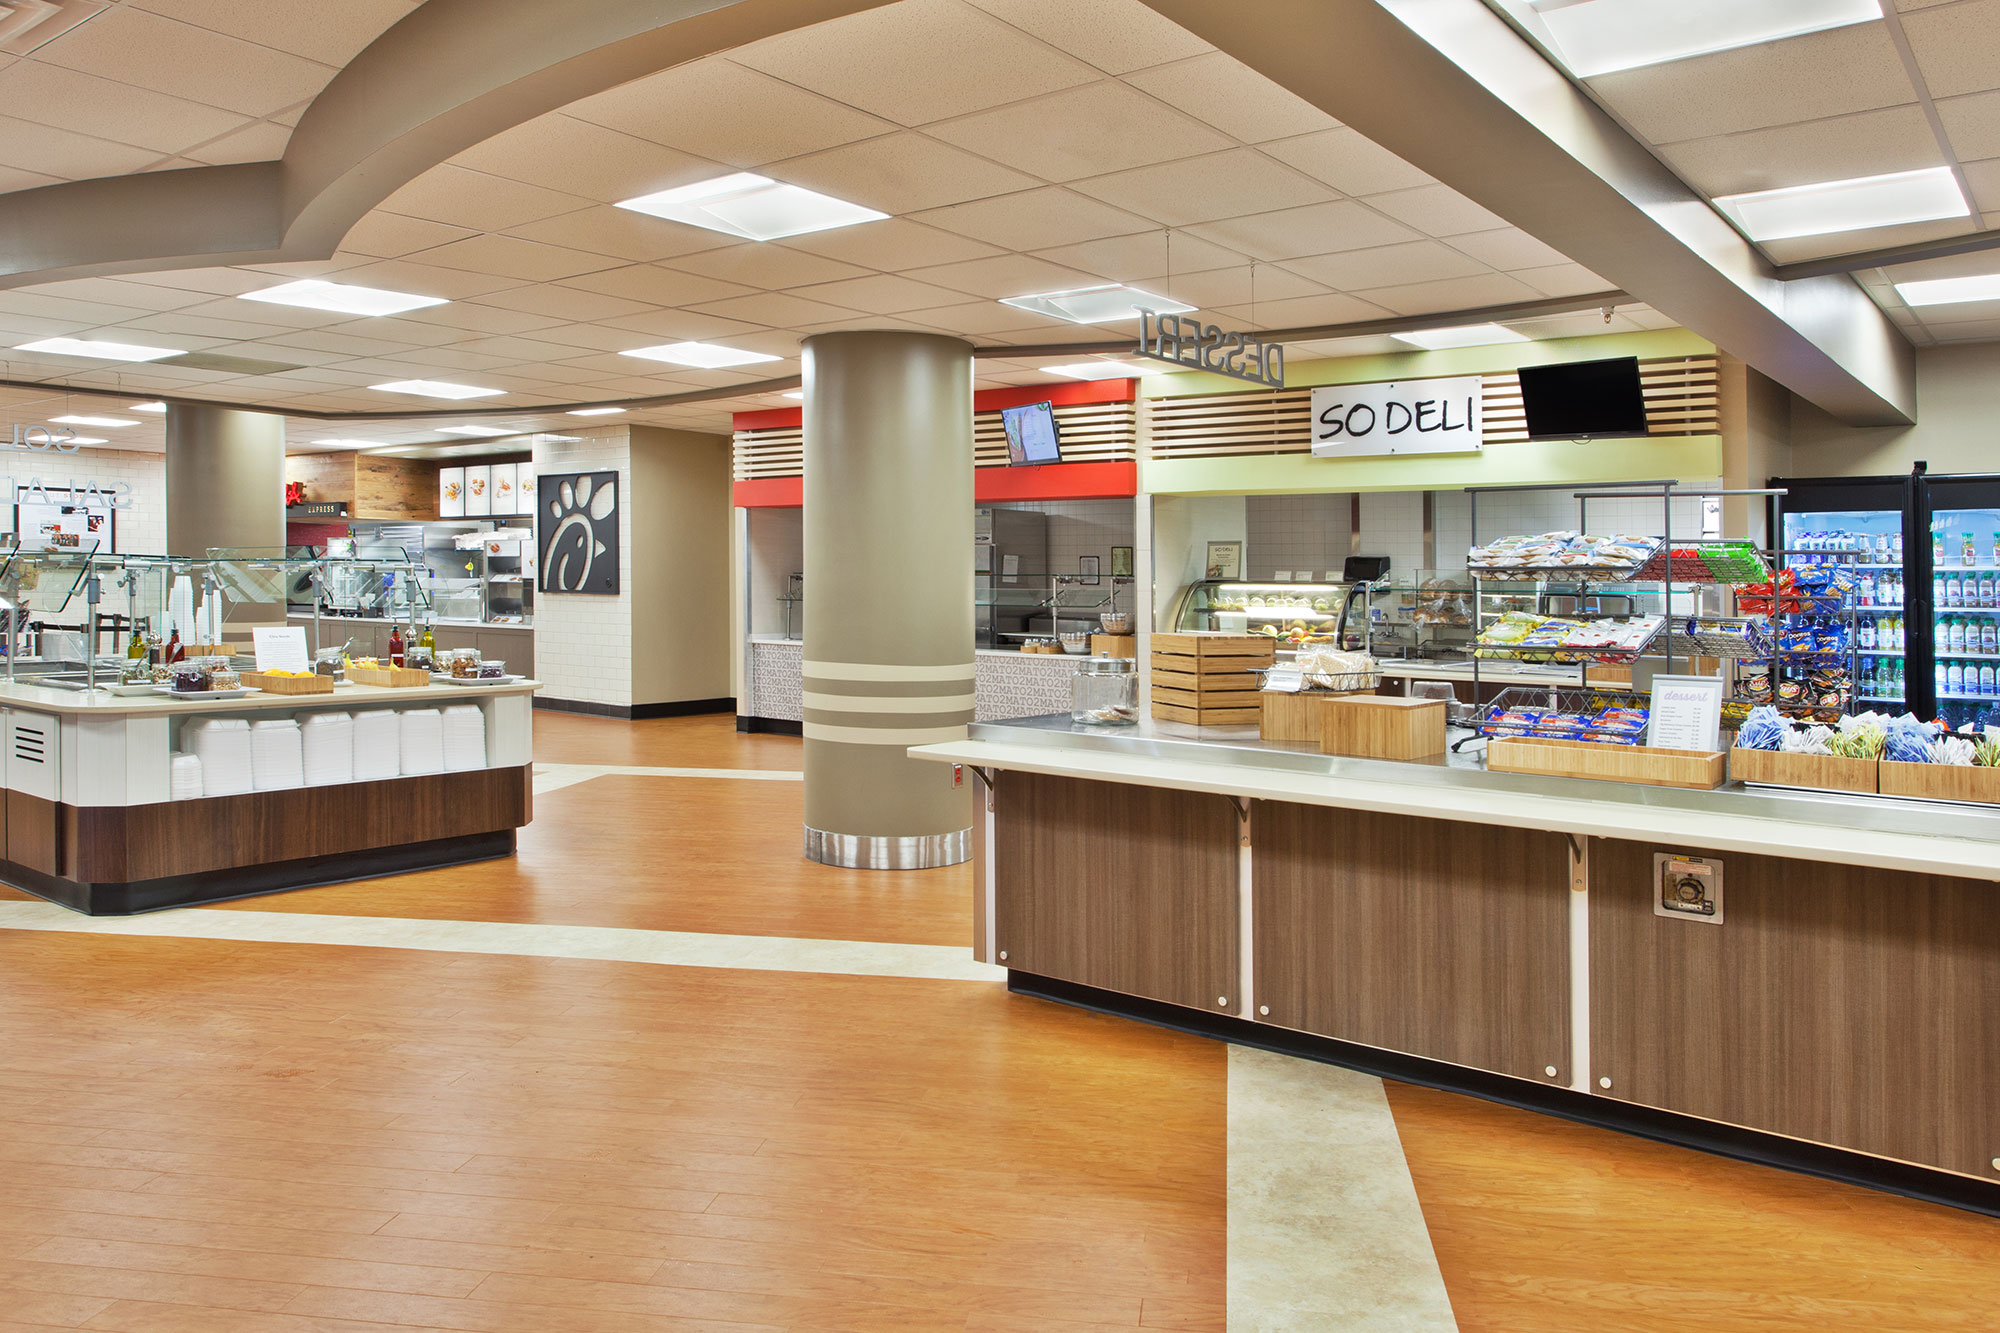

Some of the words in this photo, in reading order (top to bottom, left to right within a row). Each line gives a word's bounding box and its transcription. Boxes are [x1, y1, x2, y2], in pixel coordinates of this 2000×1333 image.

[1319, 402, 1376, 440] SO
[1385, 396, 1474, 435] DELI
[1664, 690, 1709, 702] dessert
